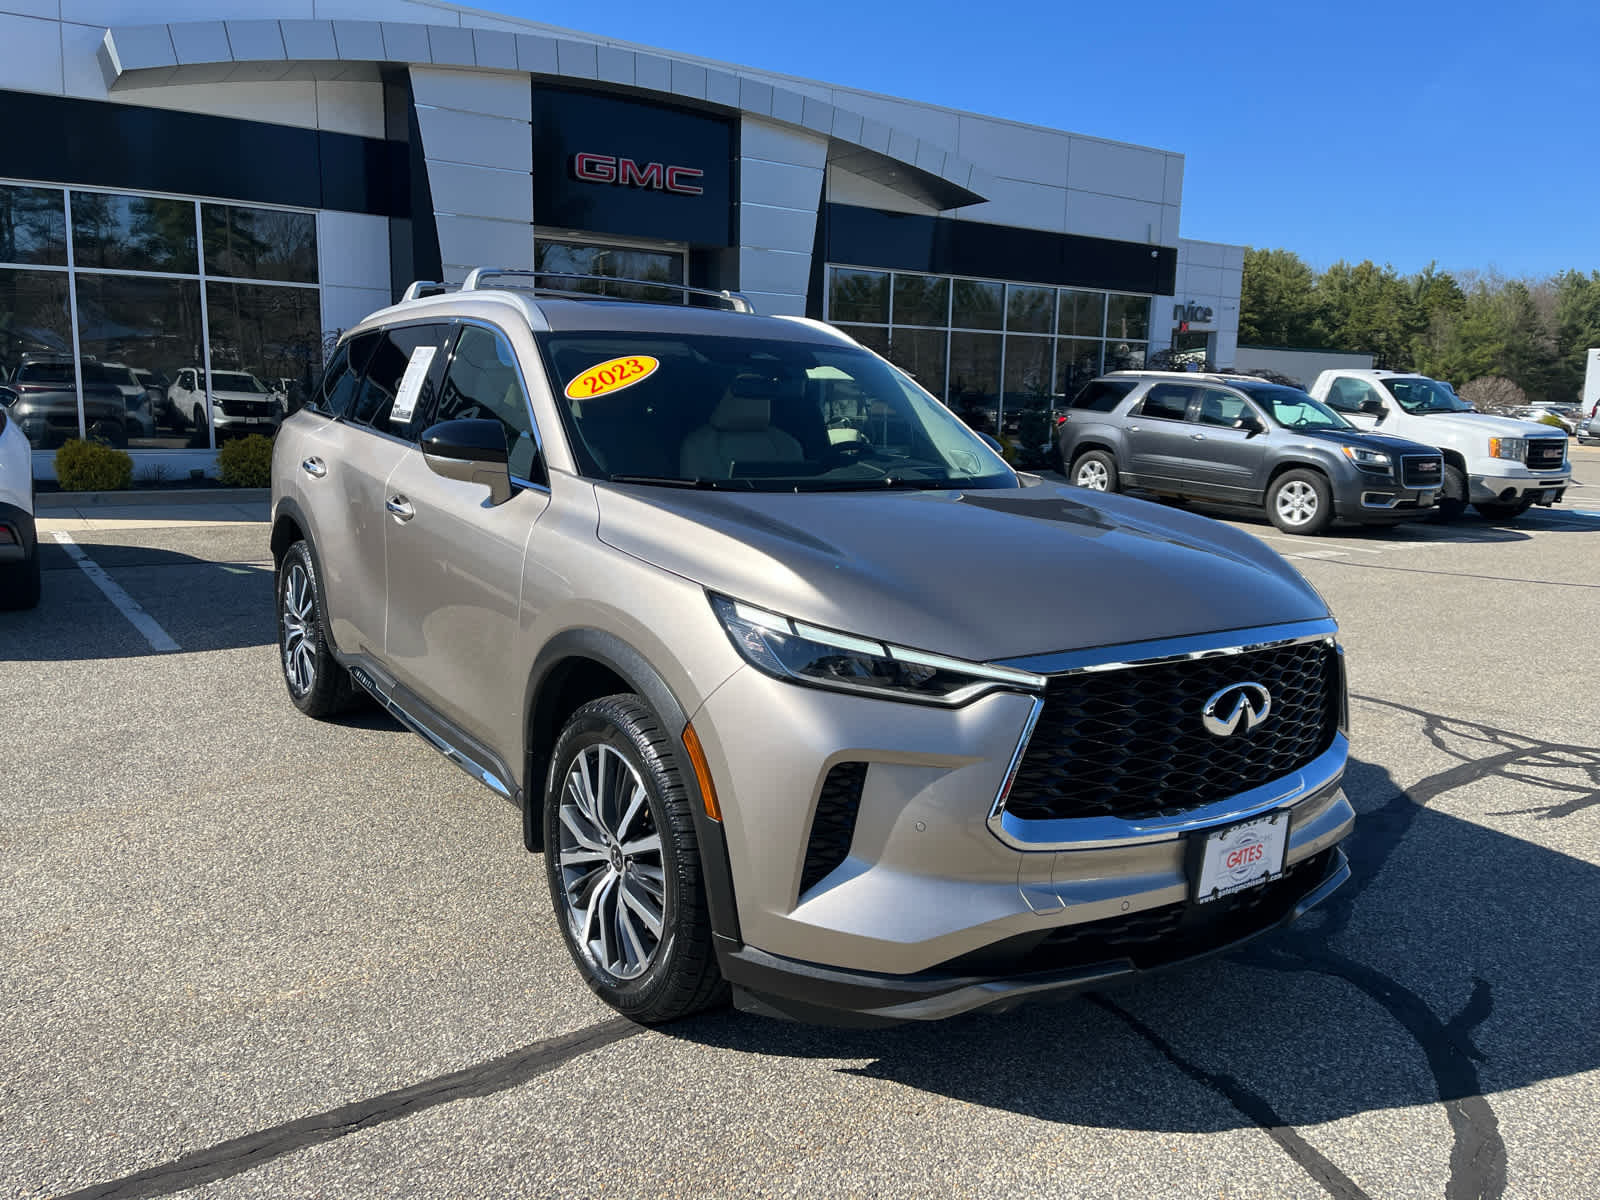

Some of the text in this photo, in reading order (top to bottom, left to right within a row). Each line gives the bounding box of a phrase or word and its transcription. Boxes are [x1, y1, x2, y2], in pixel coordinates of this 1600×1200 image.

[575, 152, 703, 194] GMC
[583, 359, 644, 394] 2023
[1226, 843, 1264, 869] GATES
